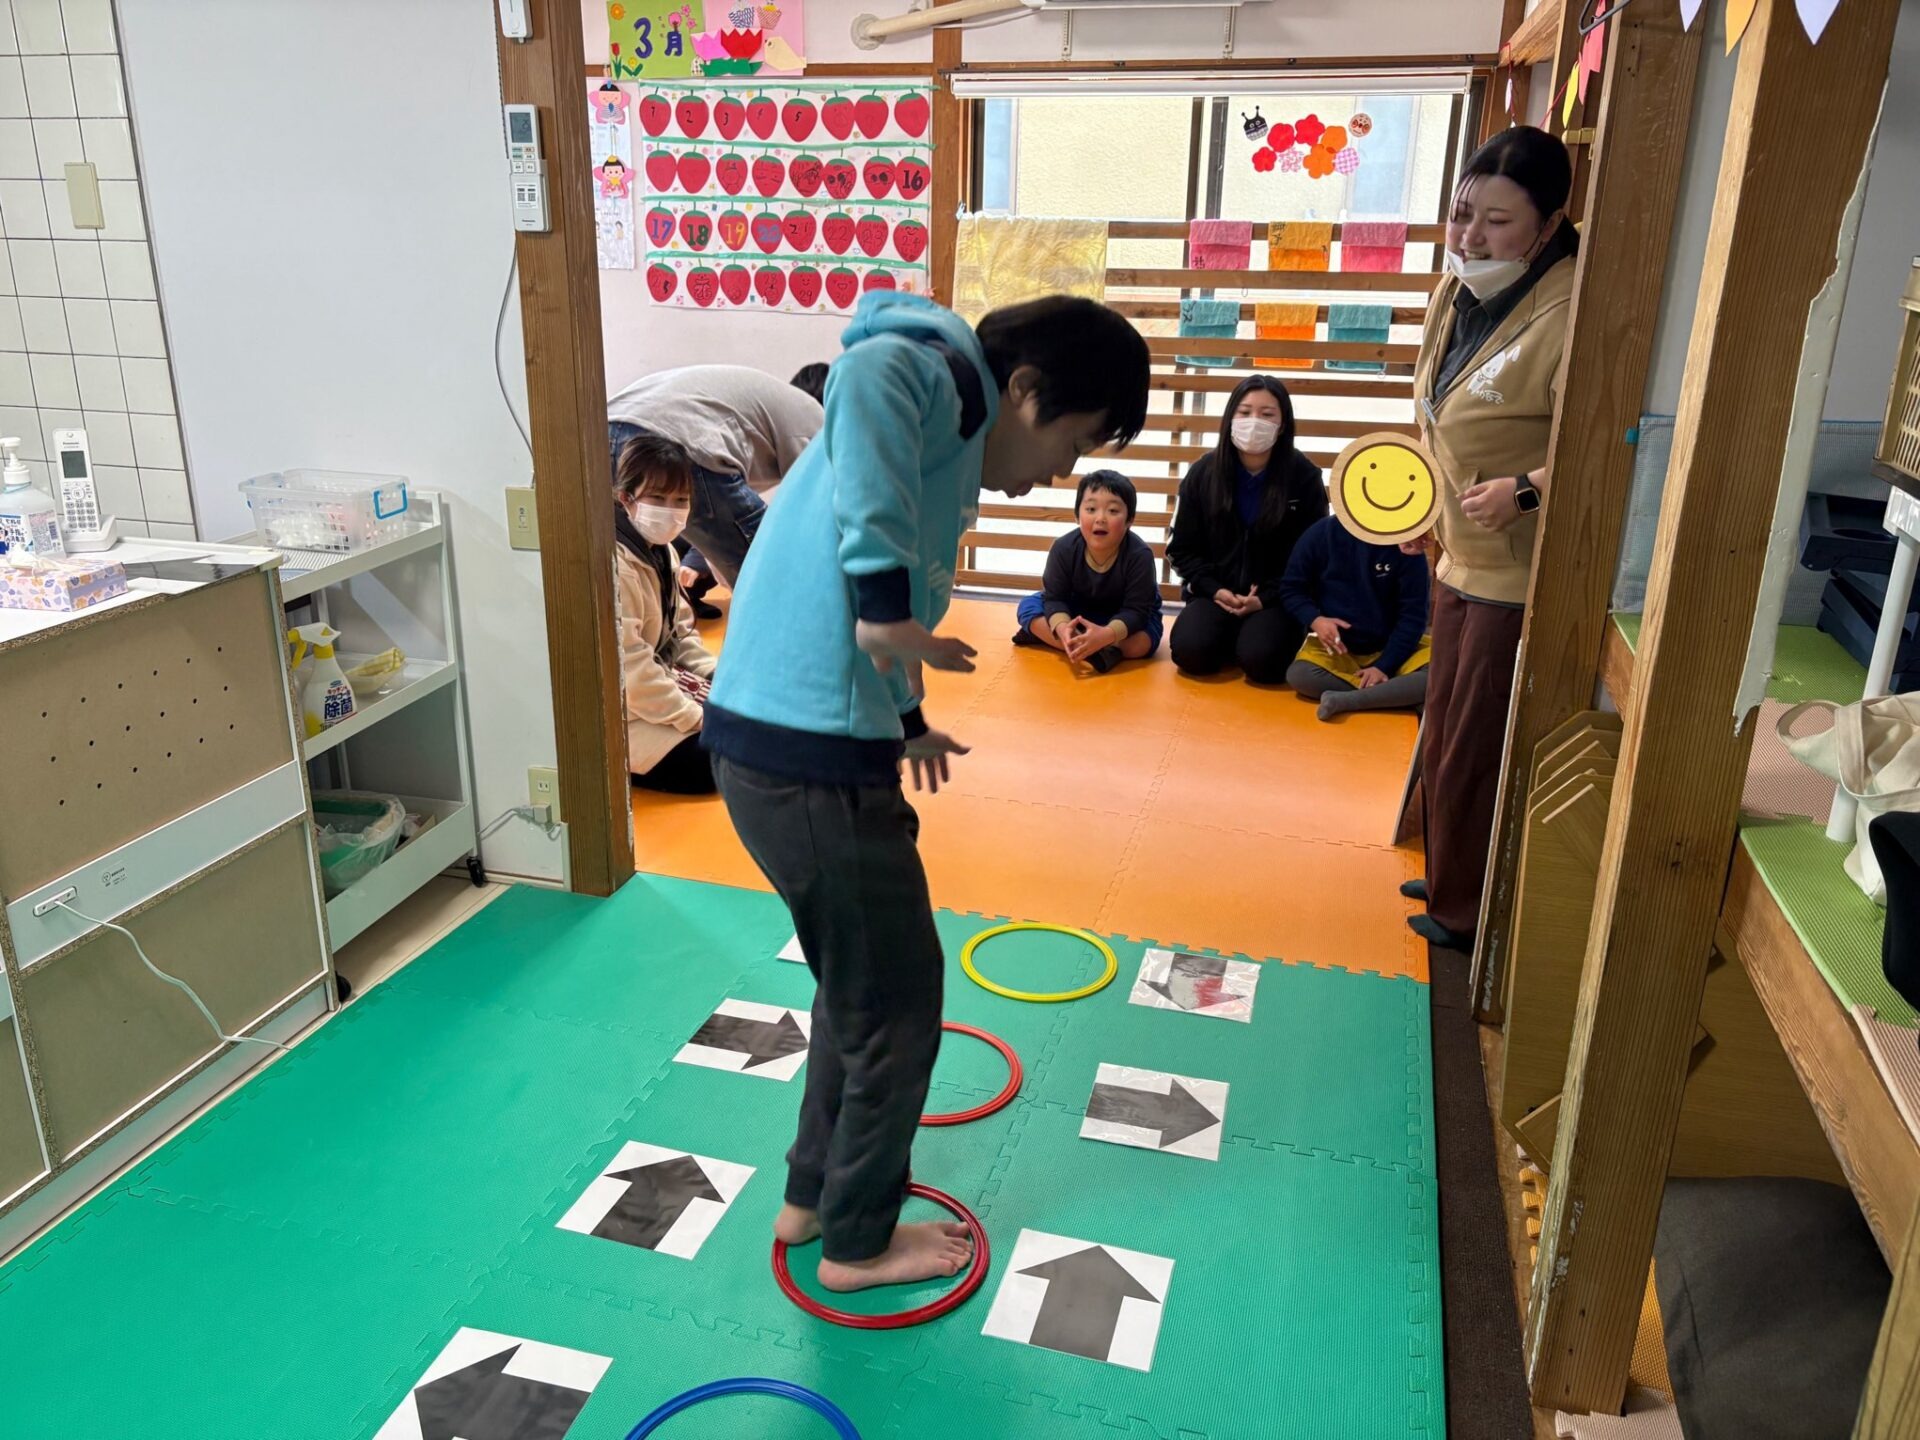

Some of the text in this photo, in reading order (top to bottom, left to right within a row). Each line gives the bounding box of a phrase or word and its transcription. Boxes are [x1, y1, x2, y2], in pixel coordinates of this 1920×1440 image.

[633, 17, 683, 58] 3月
[686, 110, 693, 123] 2
[723, 112, 729, 126] 3
[902, 169, 924, 191] 16
[652, 218, 673, 241] 17
[687, 224, 709, 247] 18
[725, 222, 745, 245] 19
[827, 226, 848, 242] 22
[324, 697, 353, 719] 除菌
